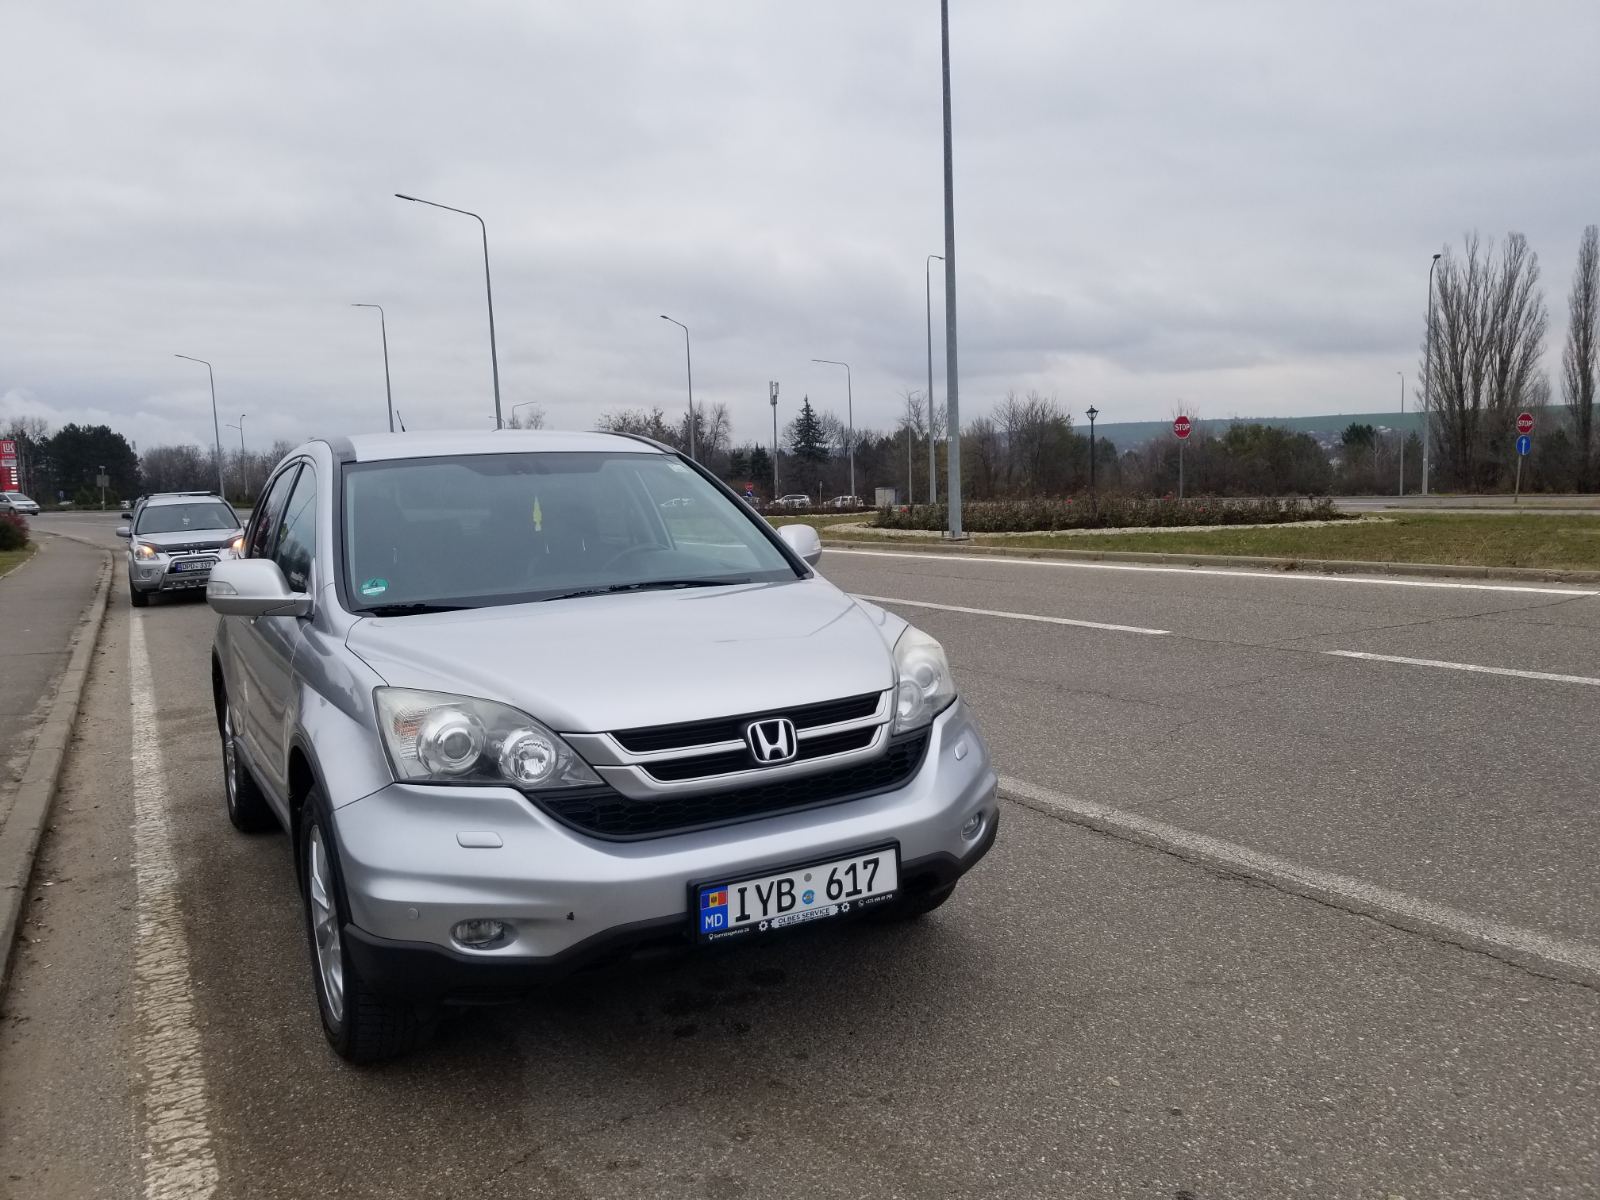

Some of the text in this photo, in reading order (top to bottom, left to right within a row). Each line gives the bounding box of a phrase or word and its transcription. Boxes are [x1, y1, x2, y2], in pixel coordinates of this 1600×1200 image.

[1175, 423, 1190, 431] STOP
[735, 857, 880, 922] IYB 617
[802, 907, 830, 919] SERVICE
[704, 913, 723, 929] MD
